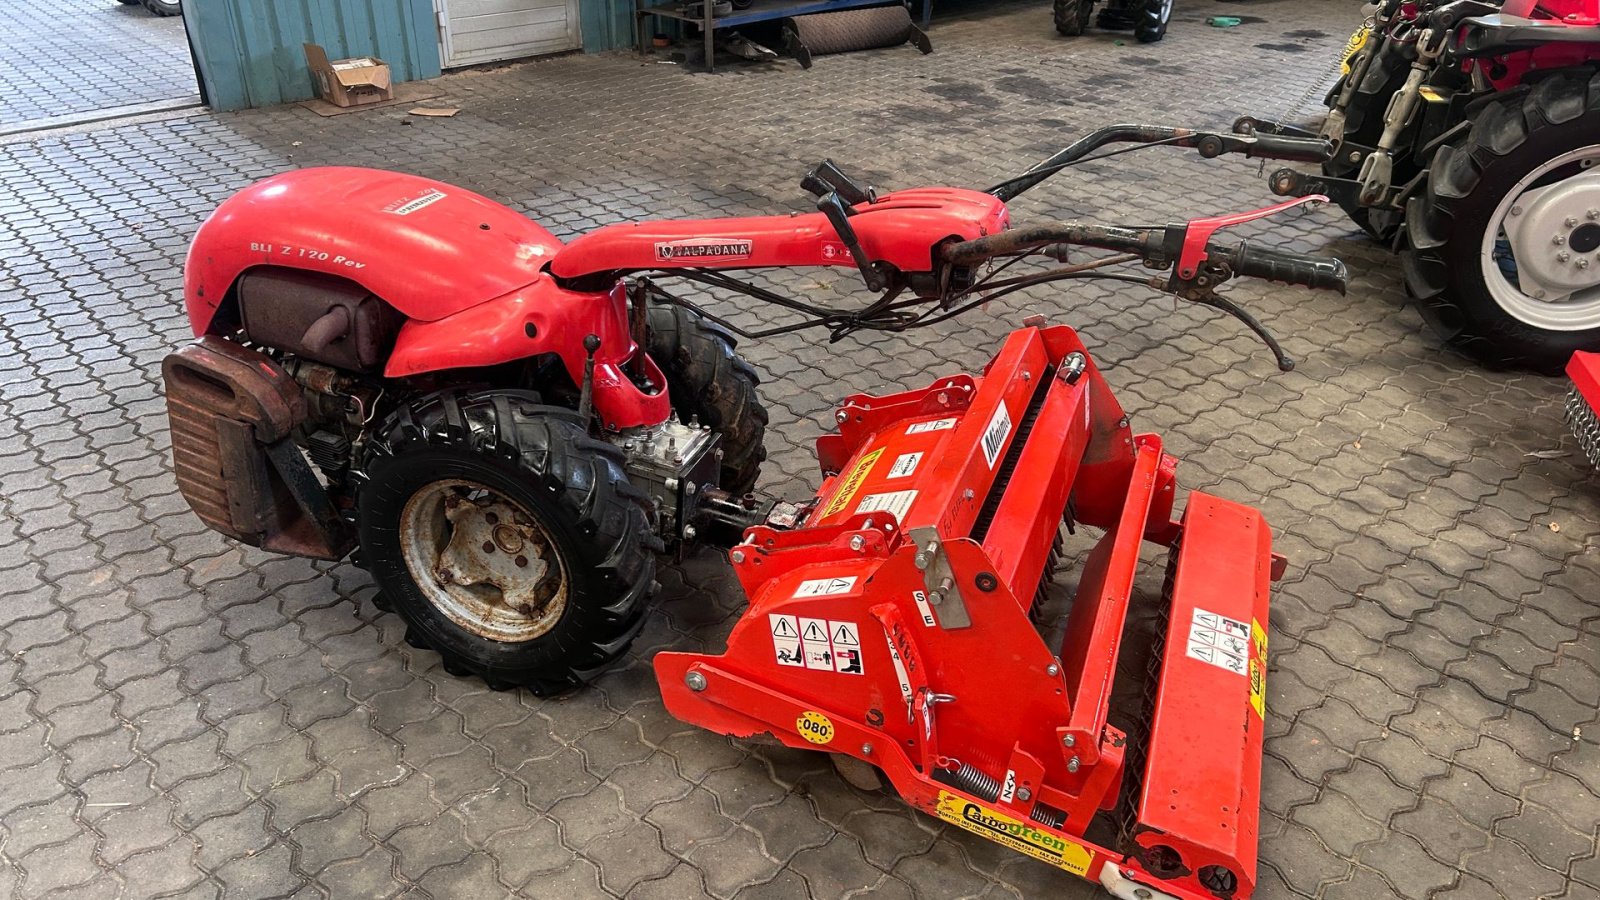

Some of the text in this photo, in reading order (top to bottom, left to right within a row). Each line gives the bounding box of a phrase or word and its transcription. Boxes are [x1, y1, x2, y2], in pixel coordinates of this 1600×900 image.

[676, 244, 747, 256] VALPADANA
[299, 248, 329, 260] 120
[333, 255, 366, 269] Rev
[916, 592, 925, 602] S
[924, 615, 934, 624] E
[893, 652, 900, 660] 4
[902, 683, 909, 692] 5
[803, 718, 828, 737] 080
[963, 803, 1065, 851] Carbogreen
